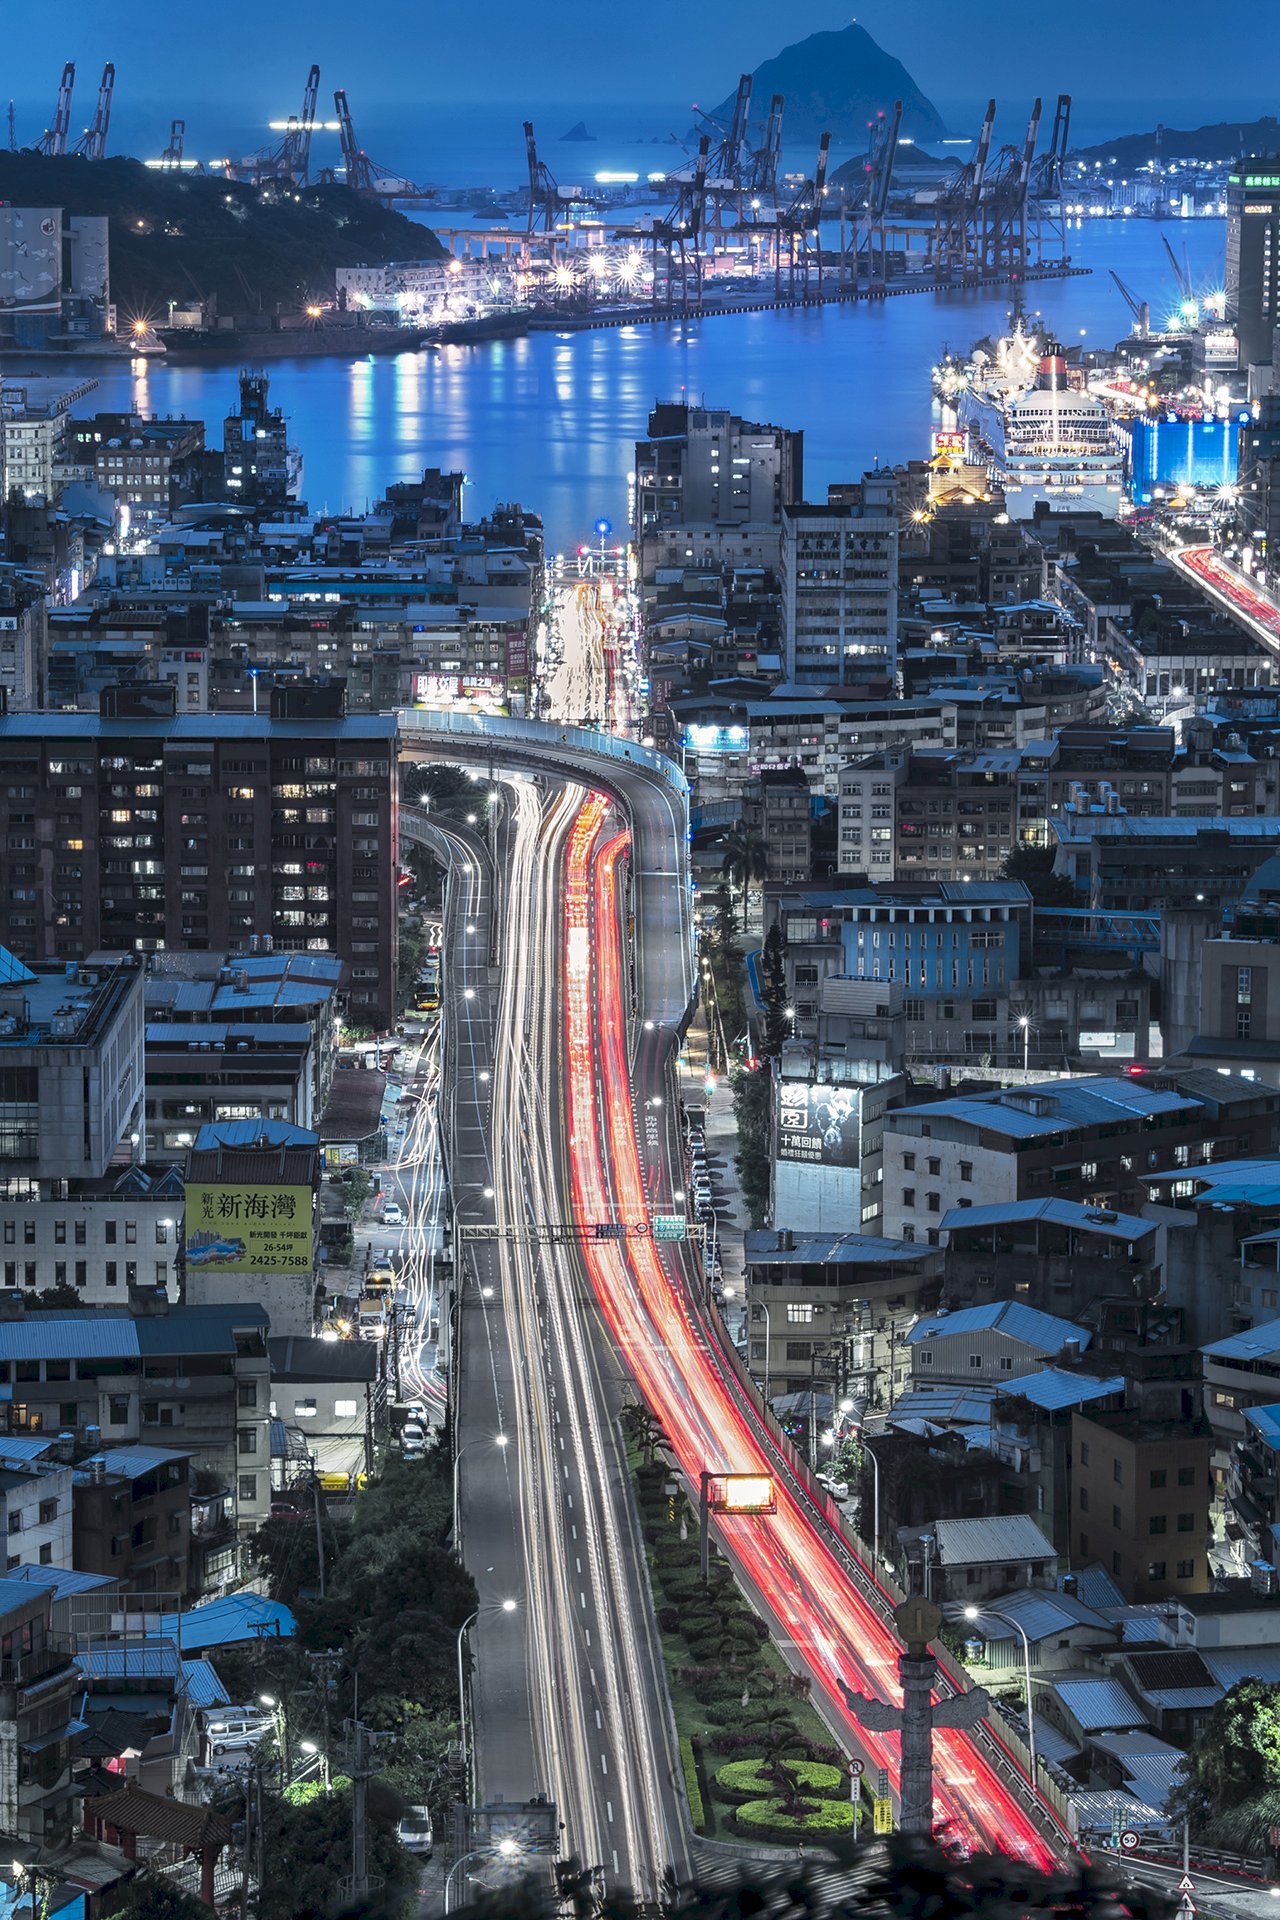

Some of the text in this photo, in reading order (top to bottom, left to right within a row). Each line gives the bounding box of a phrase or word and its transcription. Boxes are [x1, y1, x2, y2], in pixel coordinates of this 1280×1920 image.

[780, 1134, 822, 1149] 十萬回饋
[202, 1193, 213, 1218] 新光
[217, 1193, 296, 1219] 新海灣
[249, 1231, 277, 1239] 新光開發
[263, 1243, 293, 1252] 26-54坪
[250, 1255, 308, 1266] 2425-7588
[1124, 1836, 1136, 1844] 50
